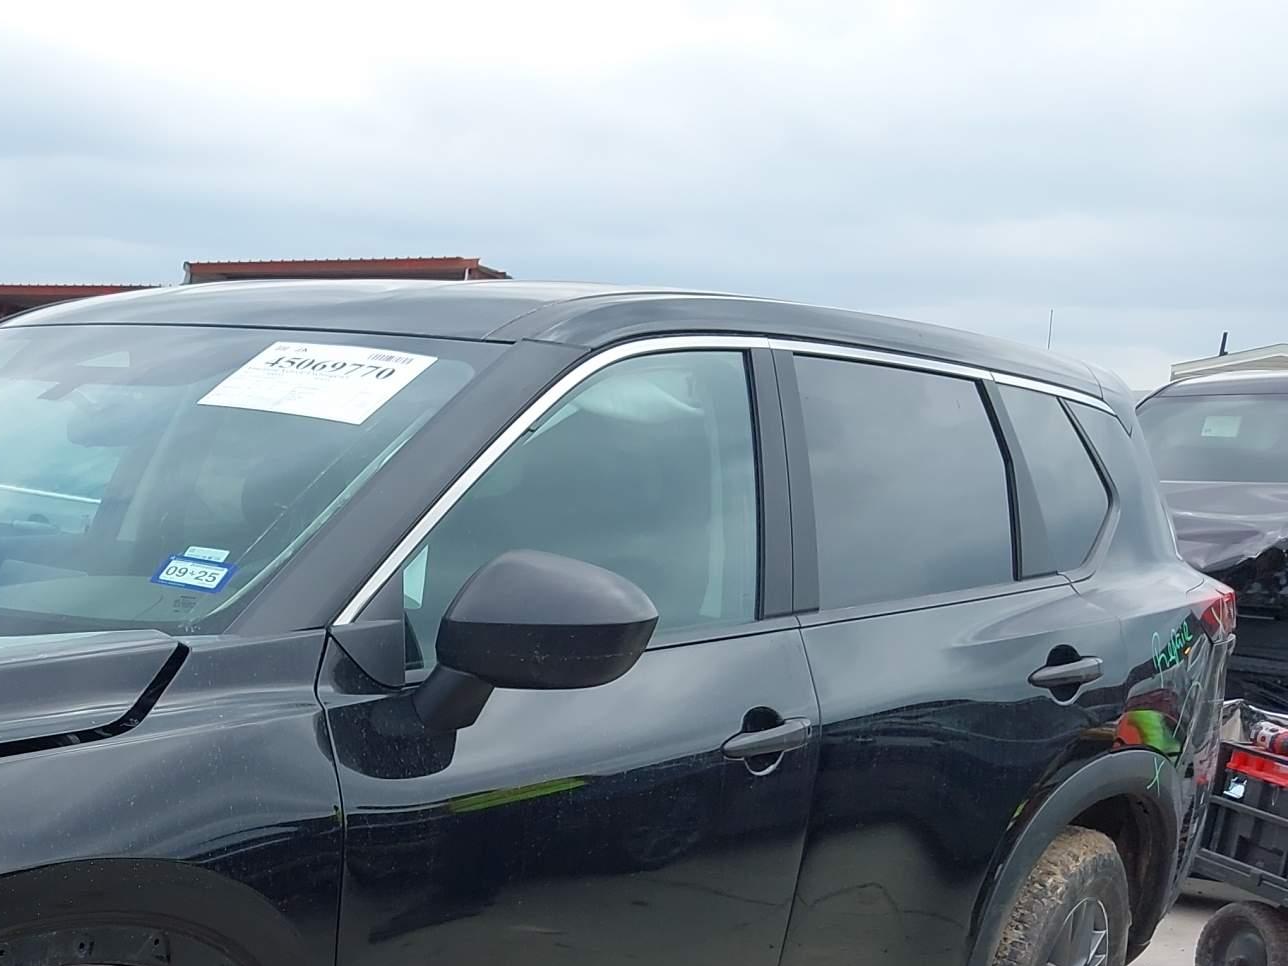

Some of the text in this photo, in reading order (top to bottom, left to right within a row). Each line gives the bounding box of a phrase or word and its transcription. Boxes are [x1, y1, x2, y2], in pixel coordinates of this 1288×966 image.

[264, 355, 397, 381] 45069770
[165, 565, 220, 584] 09 25
